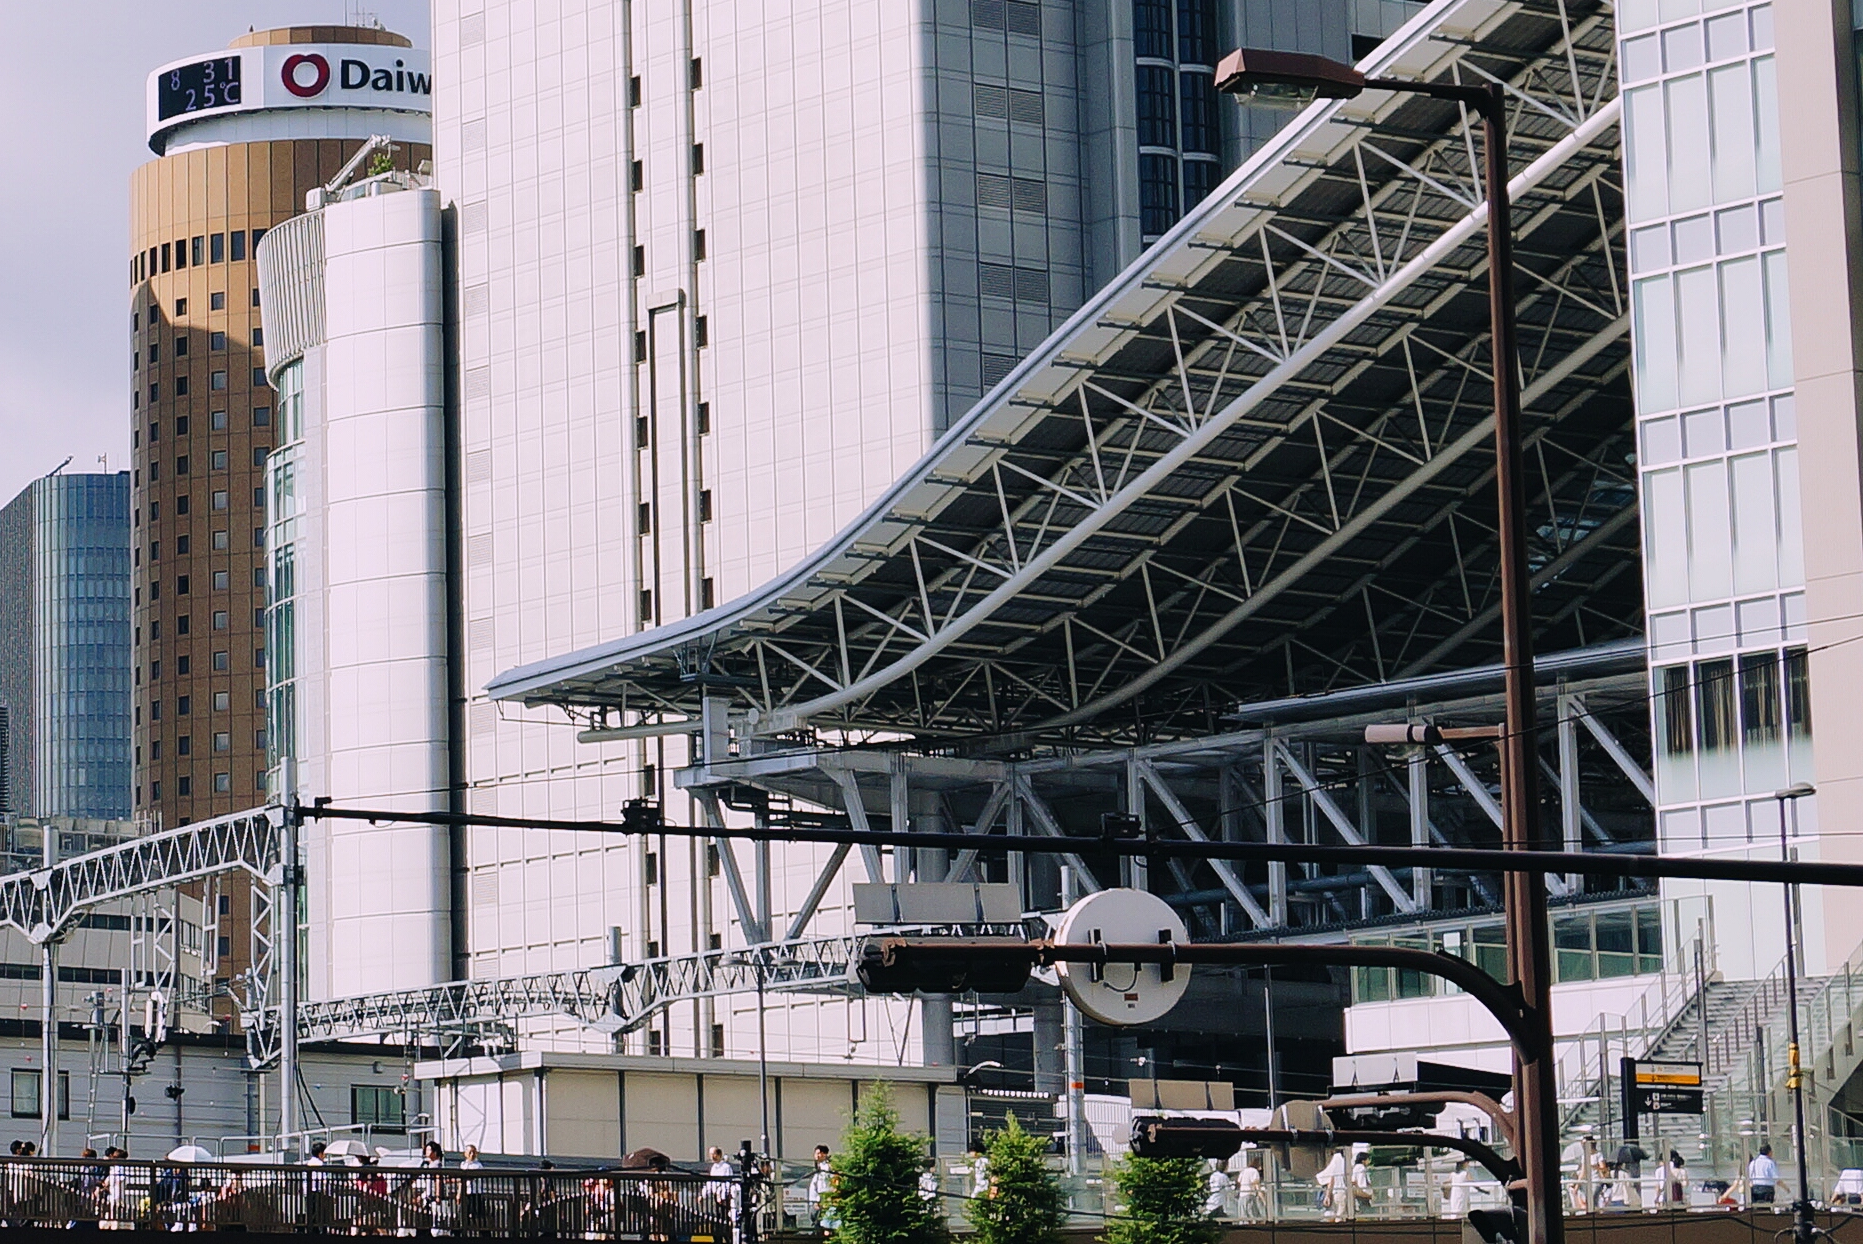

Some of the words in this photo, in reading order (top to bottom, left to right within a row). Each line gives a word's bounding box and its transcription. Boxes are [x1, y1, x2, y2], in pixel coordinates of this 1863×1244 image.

[171, 69, 181, 90] 8
[203, 58, 234, 83] 31
[341, 59, 432, 94] Daiw
